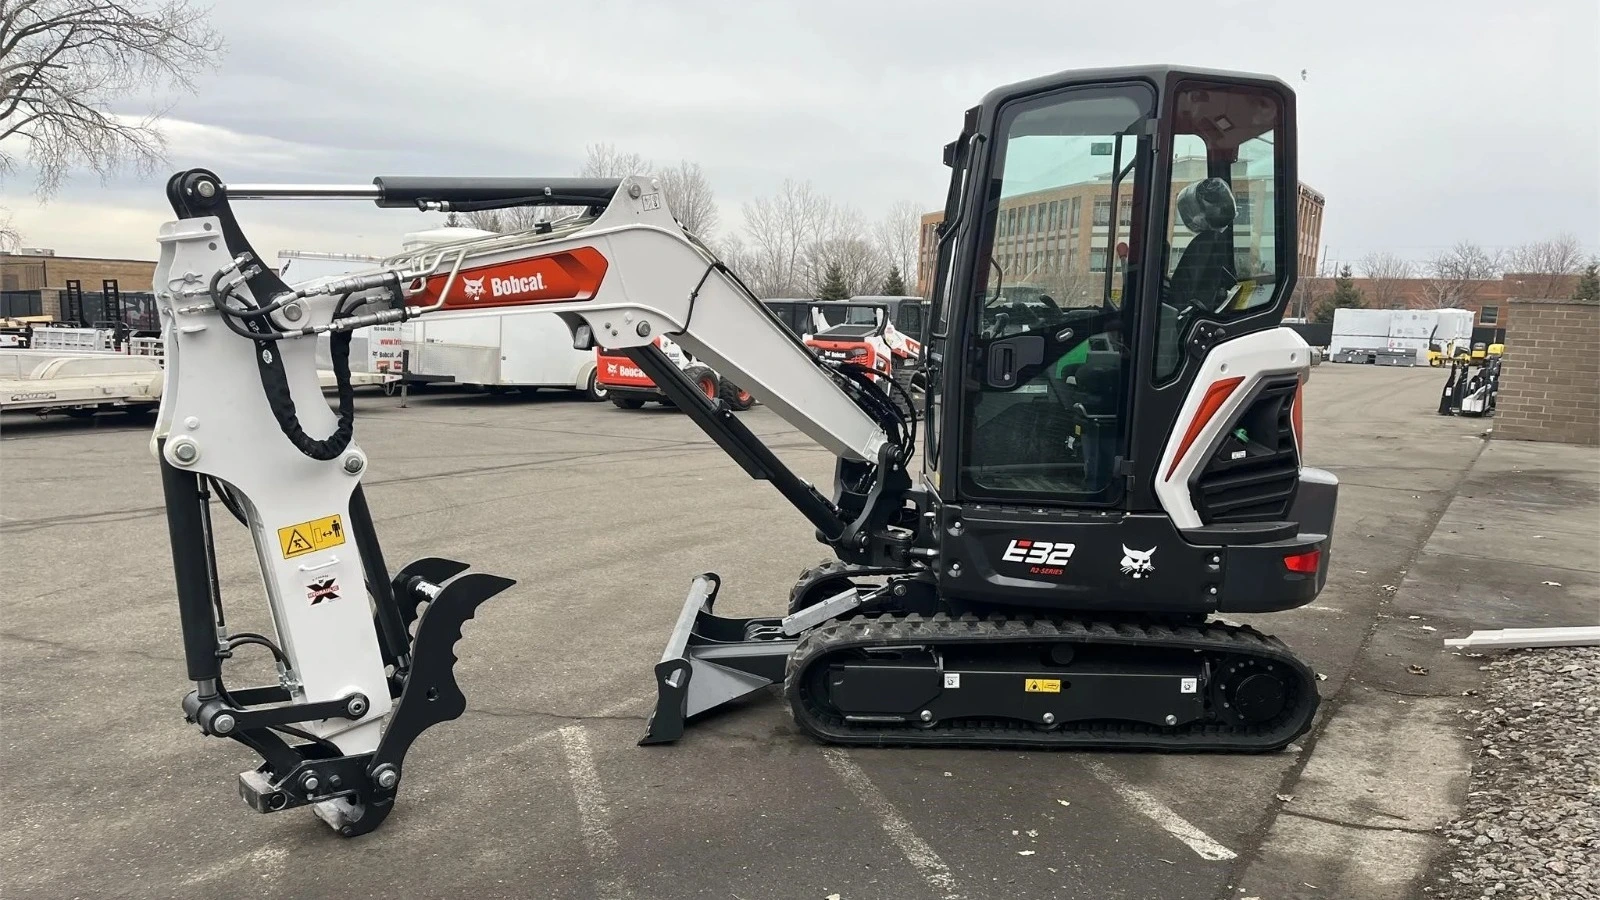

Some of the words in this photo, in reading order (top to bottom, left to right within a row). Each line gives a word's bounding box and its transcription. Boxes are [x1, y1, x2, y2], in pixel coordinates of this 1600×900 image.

[491, 273, 545, 297] Bobcat
[1002, 540, 1075, 566] E32
[1030, 567, 1063, 576] R2-SERIES
